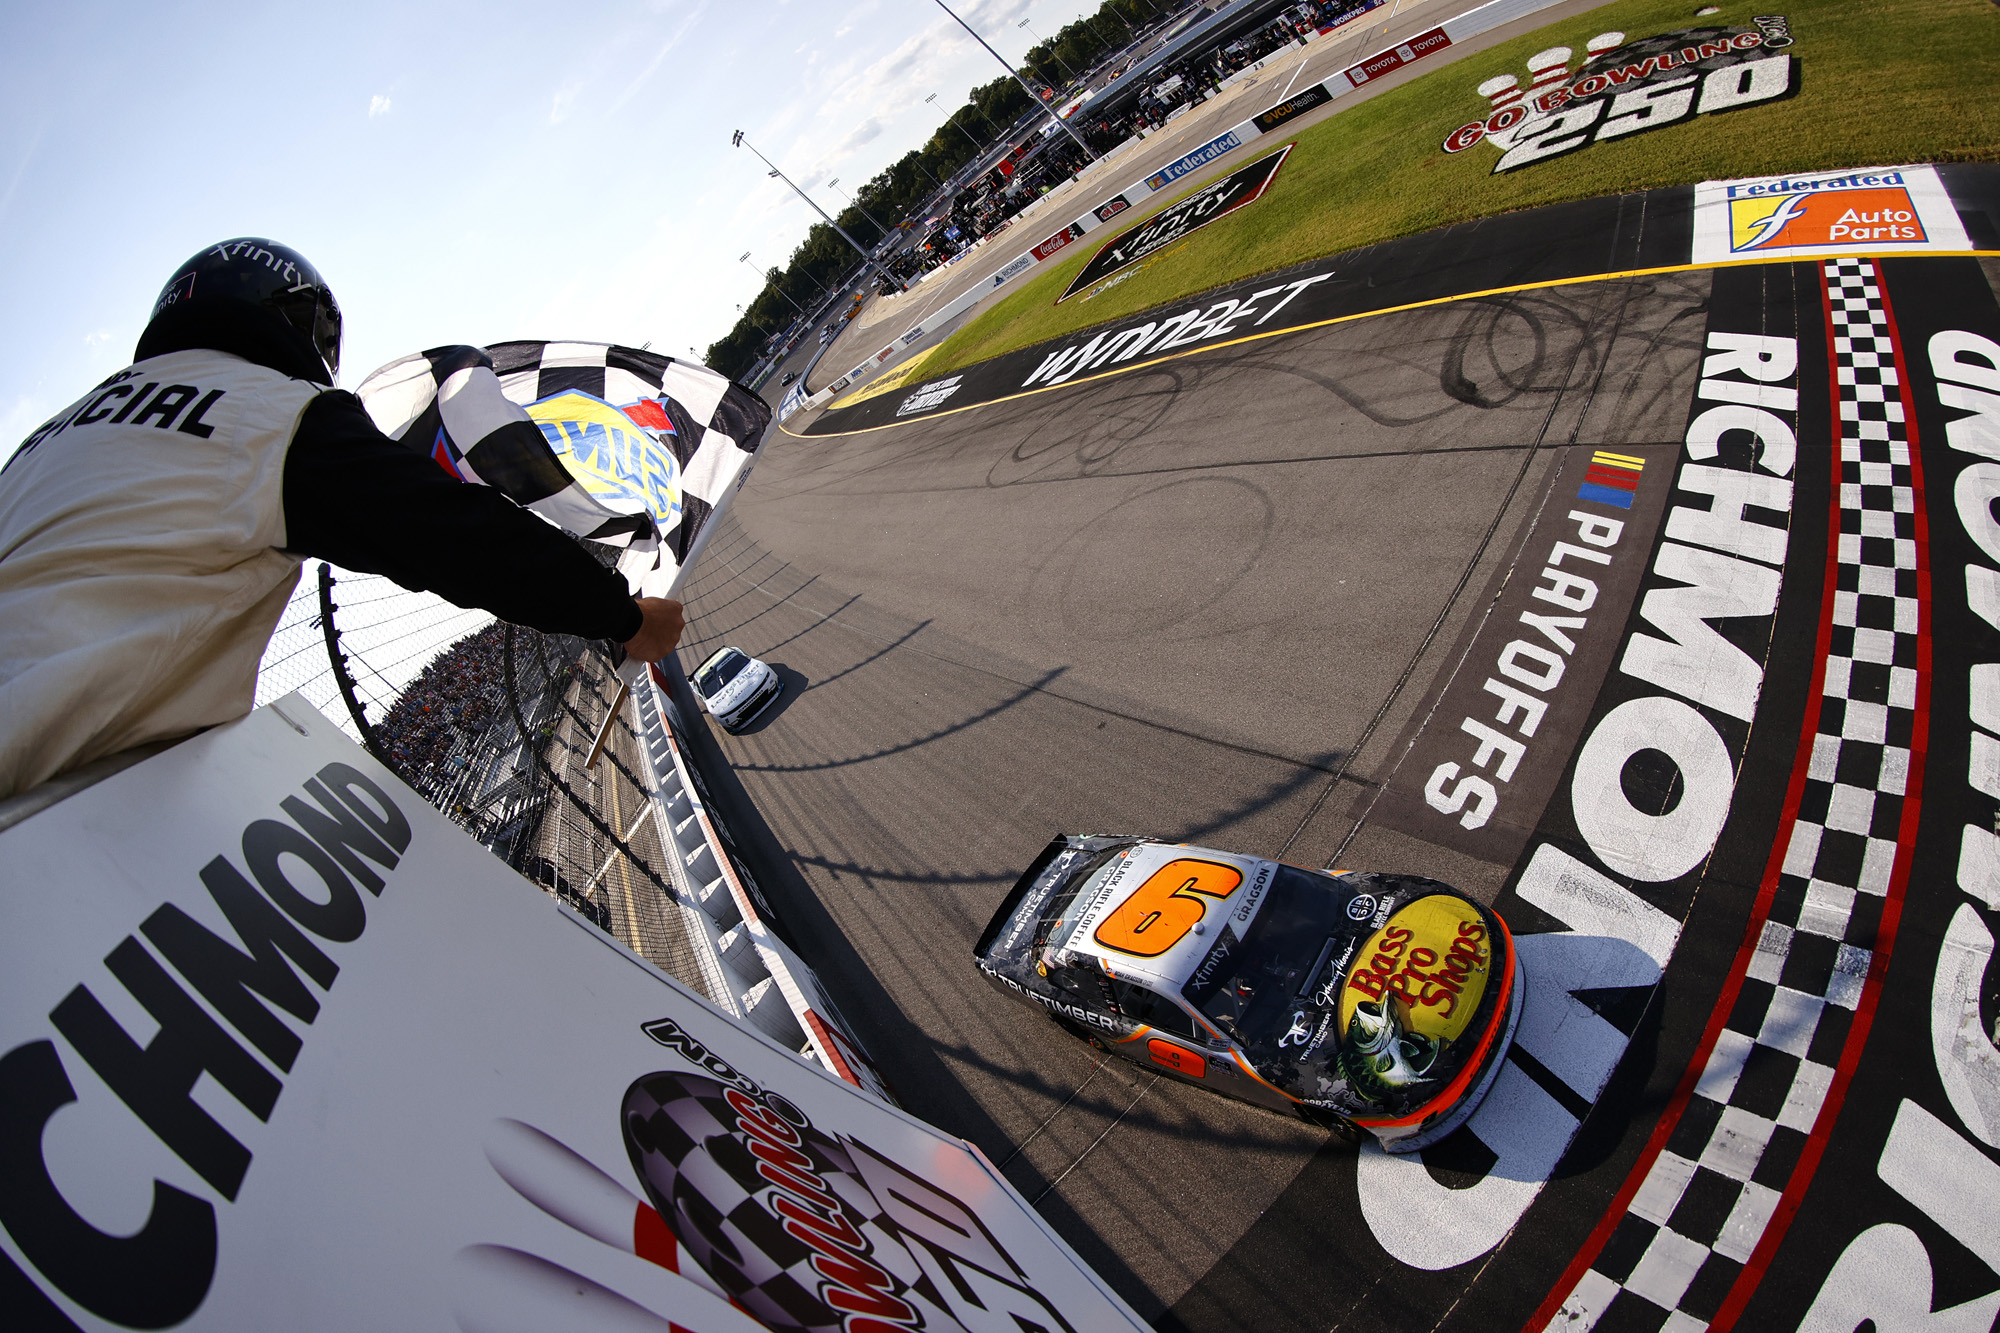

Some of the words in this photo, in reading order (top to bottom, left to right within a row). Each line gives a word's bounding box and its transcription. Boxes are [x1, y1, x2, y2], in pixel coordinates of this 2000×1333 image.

[1332, 6, 1366, 27] WORKPRO
[1366, 56, 1397, 74] TOYOTA
[1413, 34, 1445, 52] TOYOTA
[1443, 105, 1528, 153] GO
[1537, 32, 1763, 112] BOWLING
[1492, 54, 1791, 174] 250
[1164, 131, 1241, 180] Federated
[1727, 172, 1905, 198] Federated
[1101, 182, 1244, 269] xfinity
[1829, 224, 1916, 241] Parts
[1837, 208, 1911, 224] Auto
[1129, 222, 1189, 260] SERIES
[209, 241, 312, 293] xfinity
[1002, 258, 1029, 277] RICHMOND
[1425, 510, 1625, 830] PLAYOFFS
[1357, 331, 1798, 1271] RICHMOND
[1074, 866, 1116, 921] GRAGSON
[1111, 860, 1133, 887] BLACK
[1236, 867, 1270, 922] GRAGSON
[1004, 871, 1061, 953] TRUETIMBER
[1015, 892, 1035, 922] CAMO
[1091, 887, 1114, 914] RIFLE
[1379, 895, 1391, 911] RIFLE
[1069, 913, 1096, 948] COFFEE
[1192, 942, 1231, 991] xfinity
[1348, 926, 1412, 1002] Bass
[1384, 948, 1435, 1008] Pro
[1420, 921, 1488, 1019] Shops
[997, 974, 1114, 1031] TRUETIMBER
[0, 762, 412, 1333] CHMOND
[1300, 1013, 1331, 1061] TRUETIMBER
[723, 1087, 926, 1333] WLING
